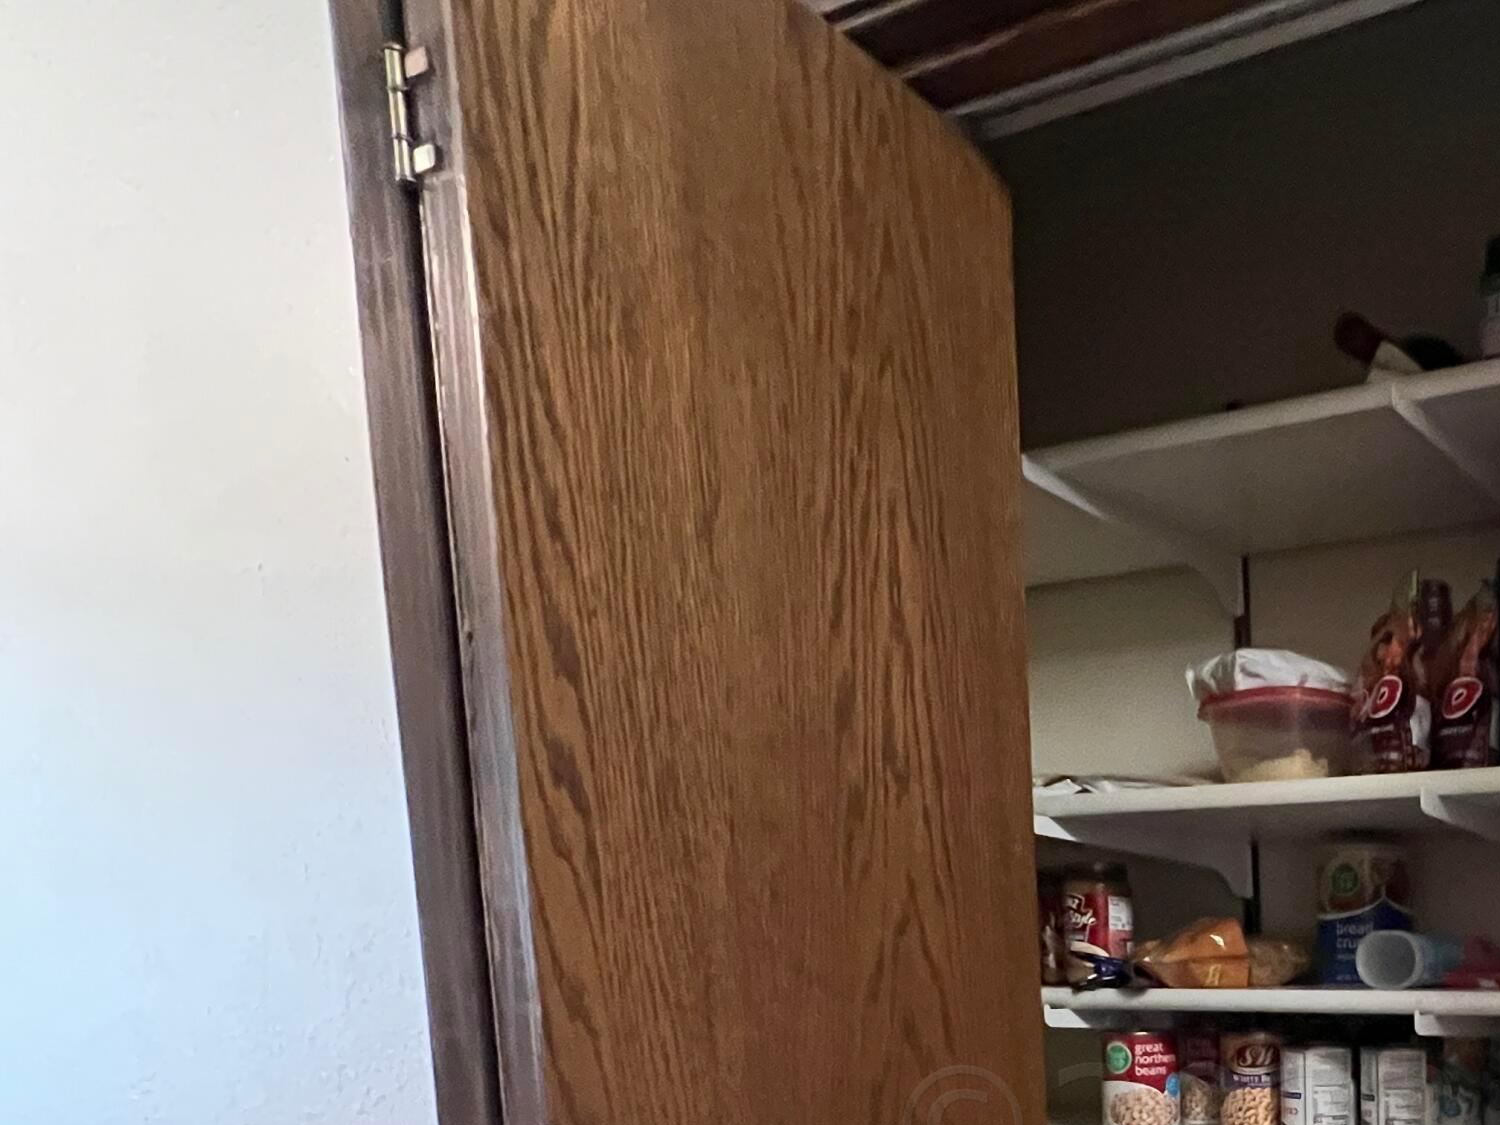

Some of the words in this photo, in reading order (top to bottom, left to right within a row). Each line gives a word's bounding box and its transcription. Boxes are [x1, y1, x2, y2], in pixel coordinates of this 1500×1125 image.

[1135, 1042, 1163, 1053] great
[1135, 1053, 1175, 1064] northern
[1135, 1064, 1167, 1076] beans
